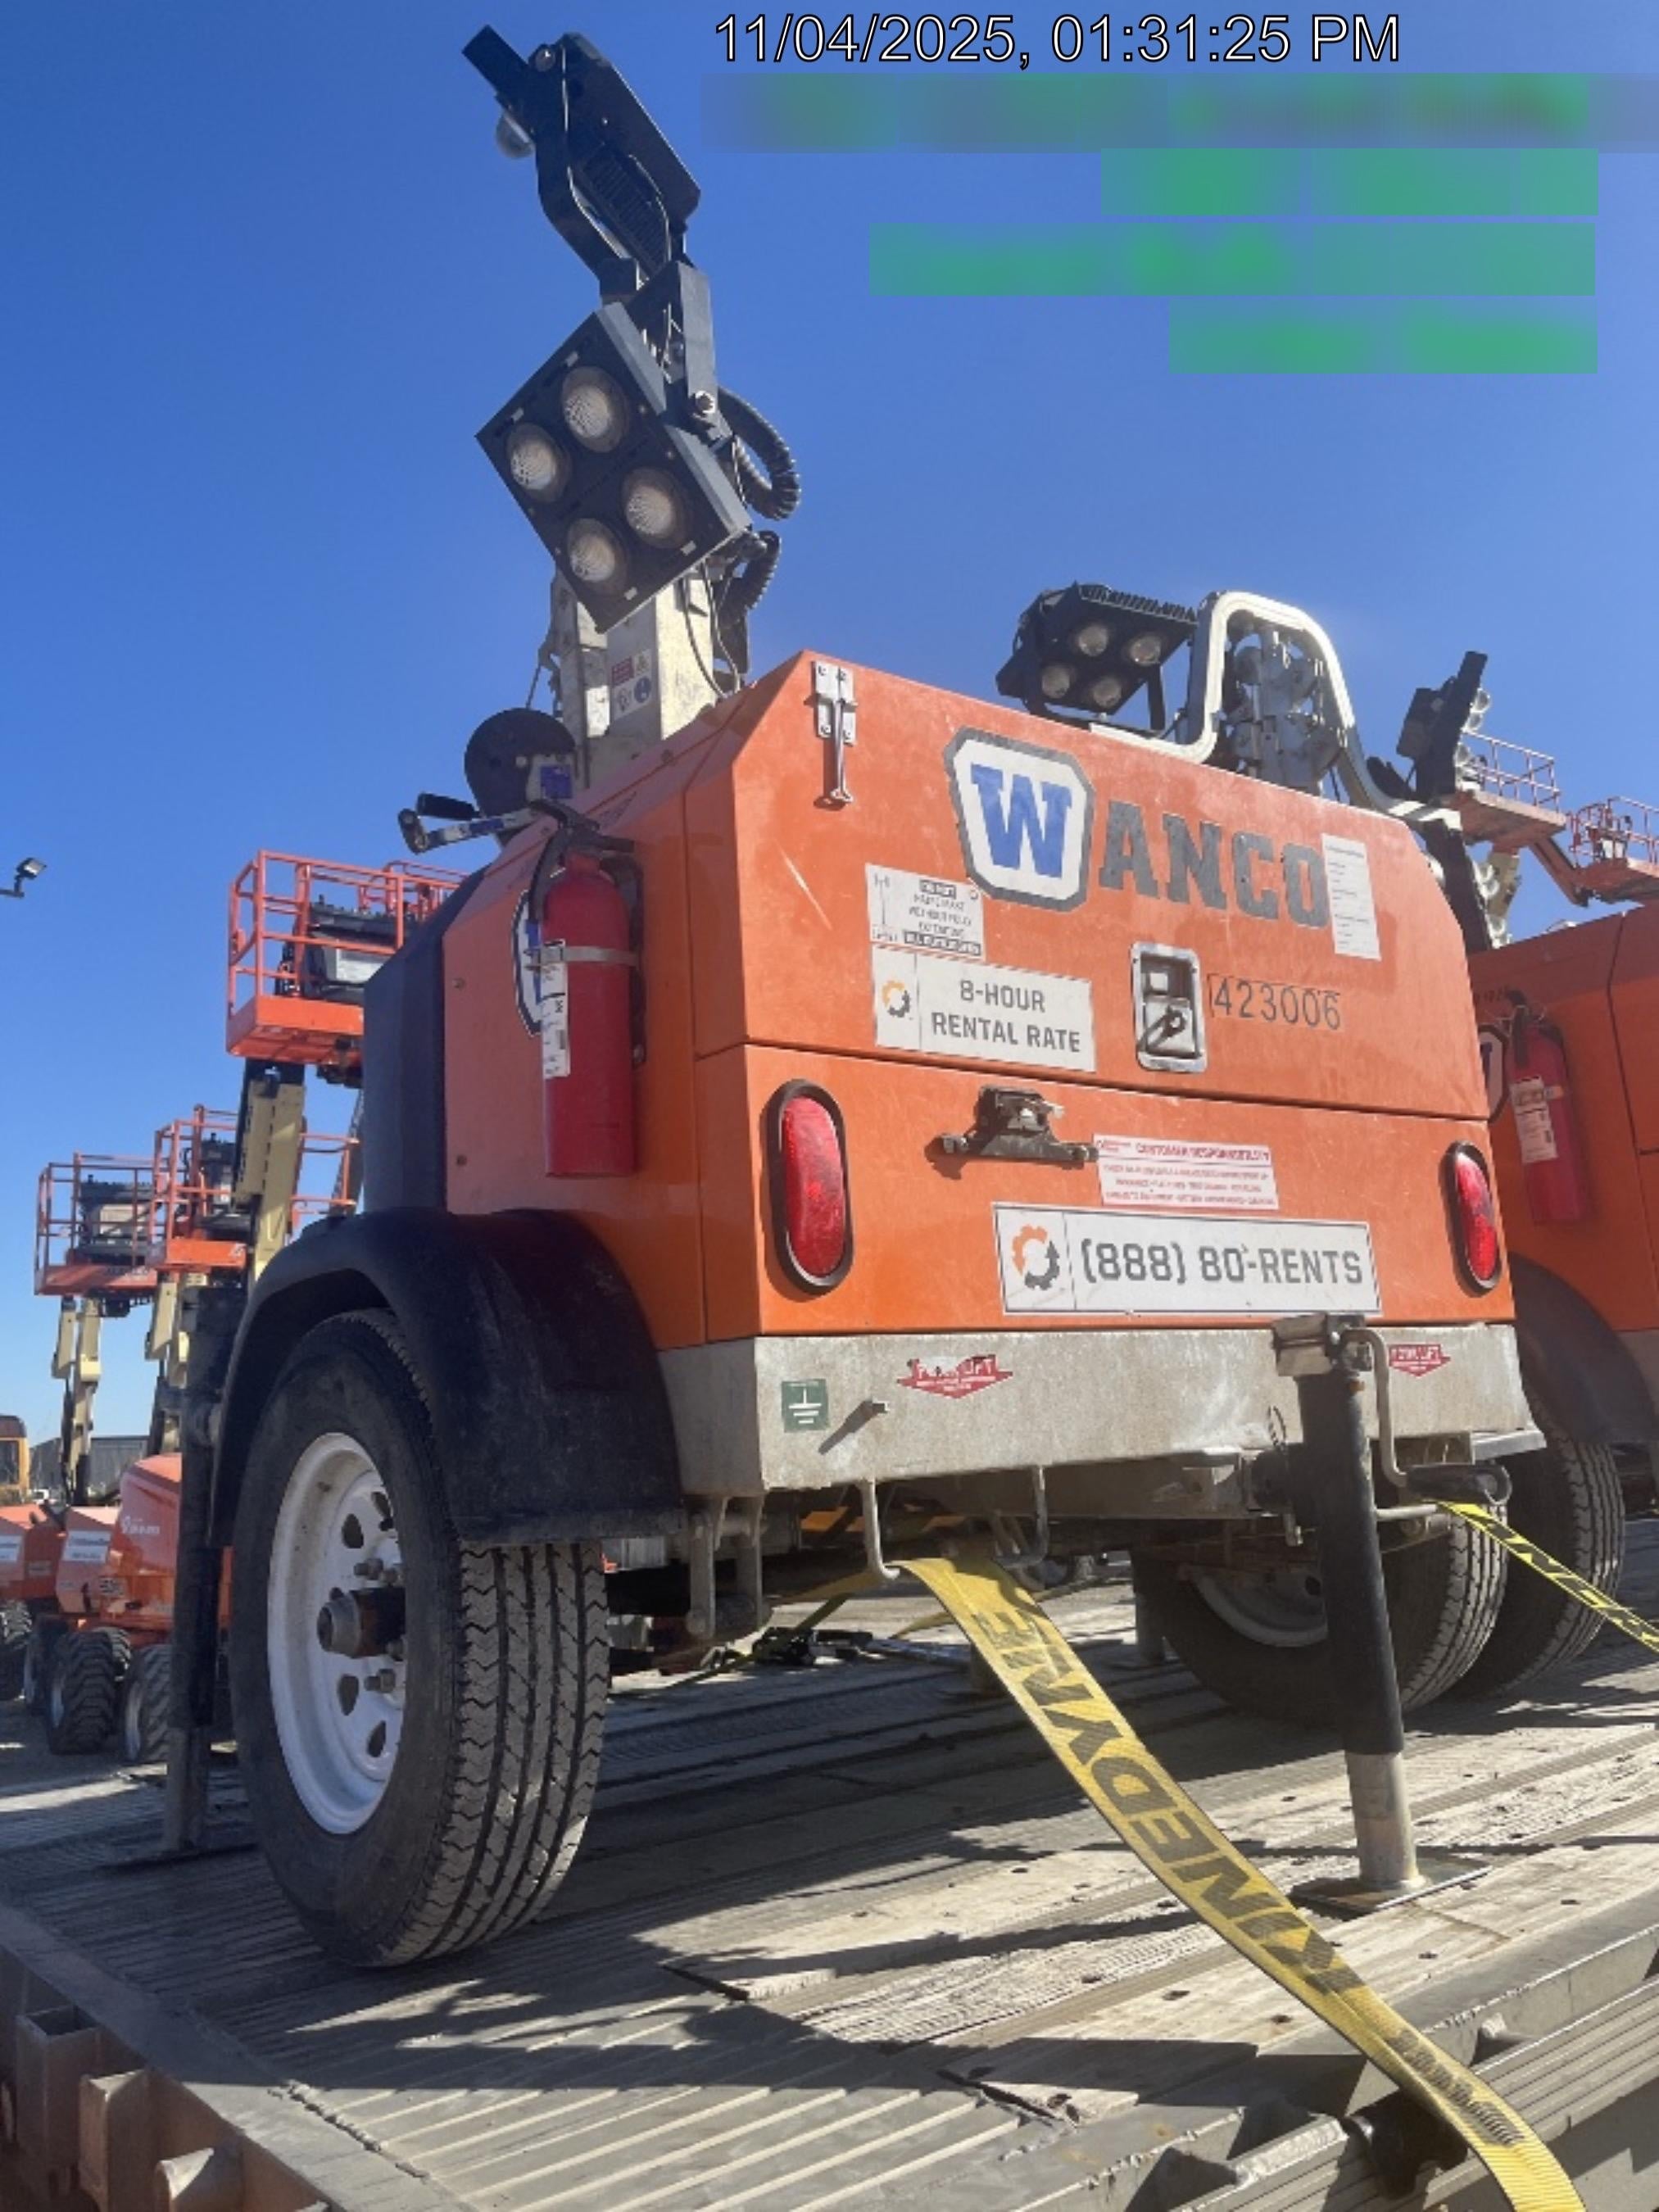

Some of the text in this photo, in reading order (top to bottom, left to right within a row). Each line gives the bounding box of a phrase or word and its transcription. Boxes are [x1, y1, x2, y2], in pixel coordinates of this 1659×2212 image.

[970, 762, 1328, 927] WANCO
[960, 980, 1045, 1013] 8-HOUR
[1214, 977, 1341, 1031] 423006
[931, 1012, 1081, 1052] RENTAL RATE
[1081, 1238, 1363, 1285] (888) 80-RENTS
[972, 1609, 1366, 1997] KINEDYNE
